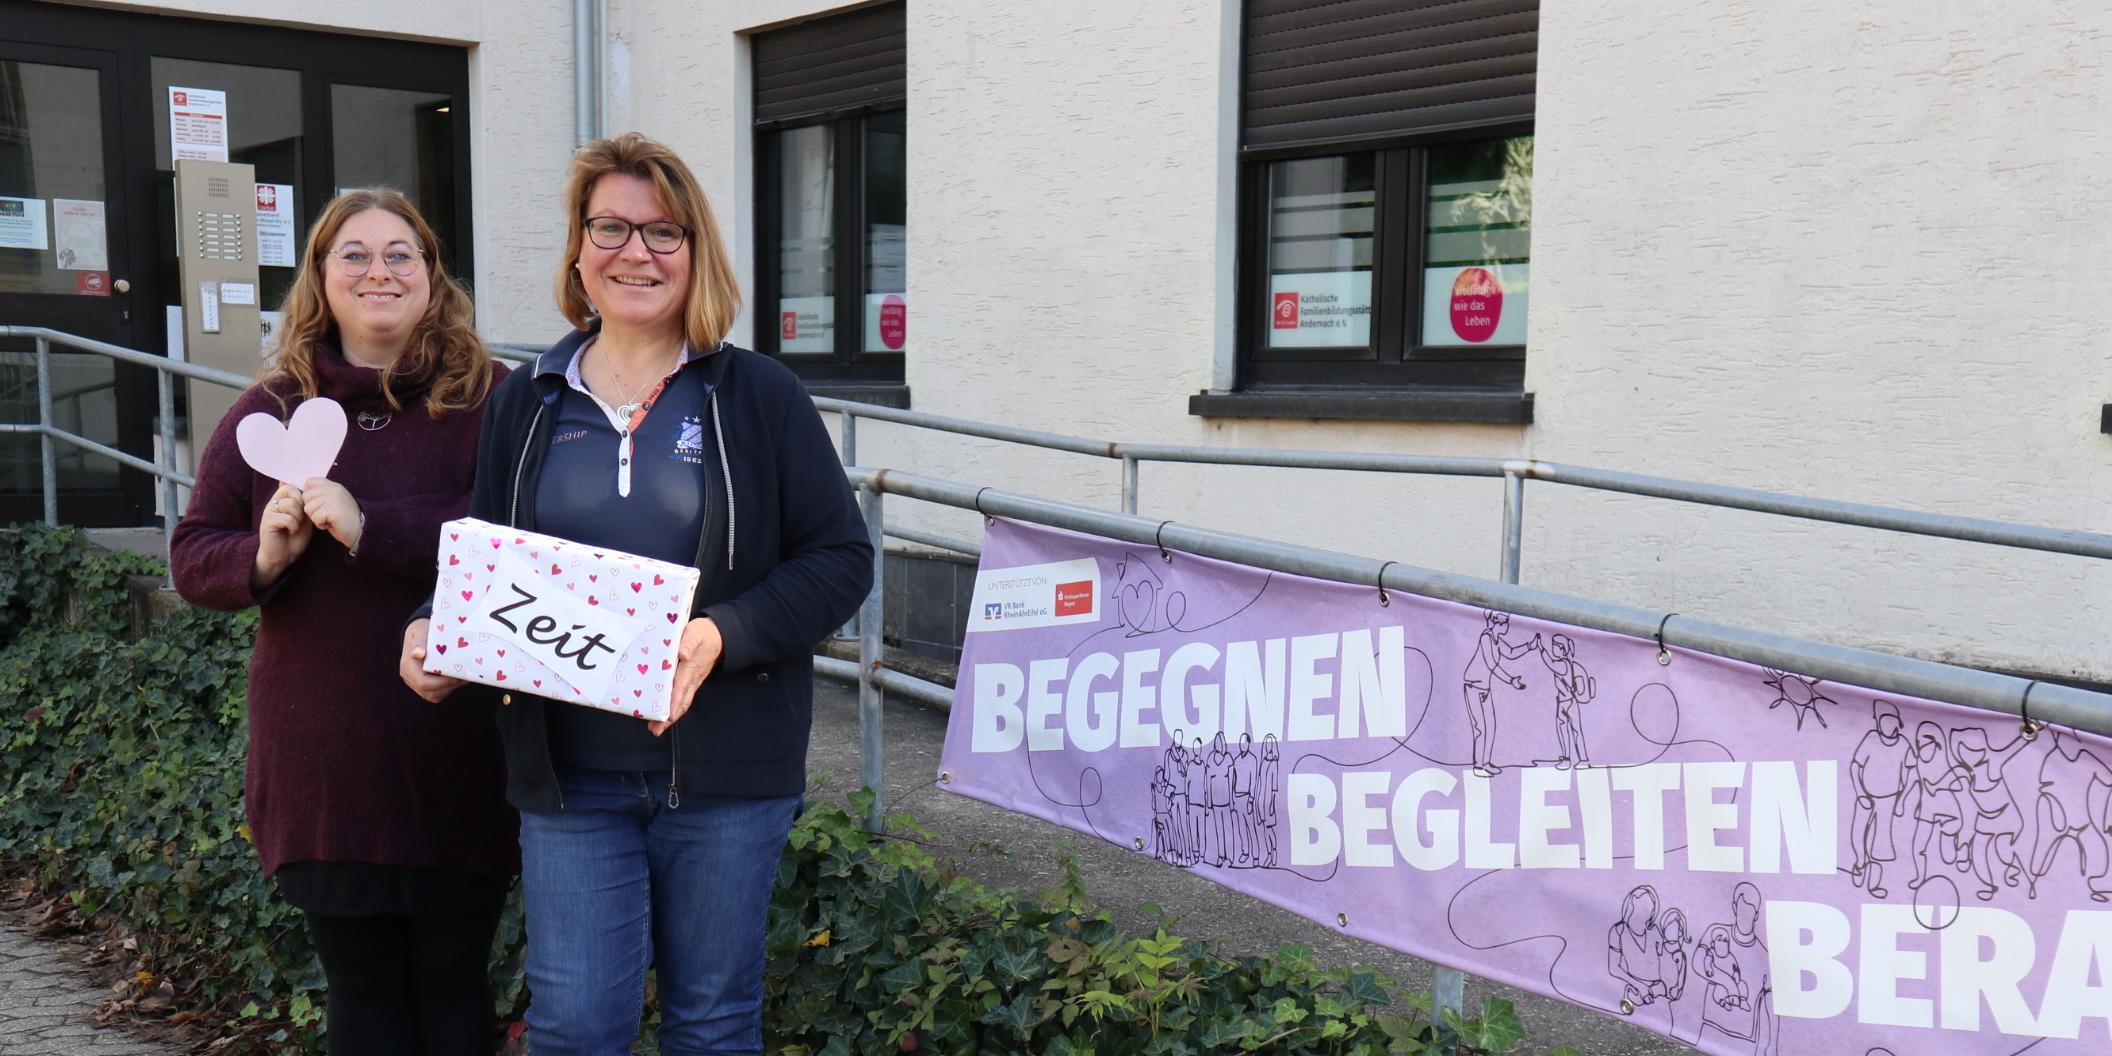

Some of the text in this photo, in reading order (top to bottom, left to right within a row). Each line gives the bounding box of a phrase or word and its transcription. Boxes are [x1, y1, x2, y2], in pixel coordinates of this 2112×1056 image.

[1301, 294, 1338, 304] Katholische
[1454, 299, 1485, 311] wie das
[1300, 319, 1335, 328] Andernach
[1465, 315, 1491, 326] Leben
[988, 576, 1048, 591] UNTERSTÜTZT VON
[1004, 600, 1025, 610] VR Bank
[1040, 608, 1048, 616] eG
[489, 582, 616, 671] Zeit
[971, 625, 1407, 754] BEGEGNEN
[1287, 759, 1838, 875] BEGLEITEN
[1765, 899, 2112, 1040] BERA
